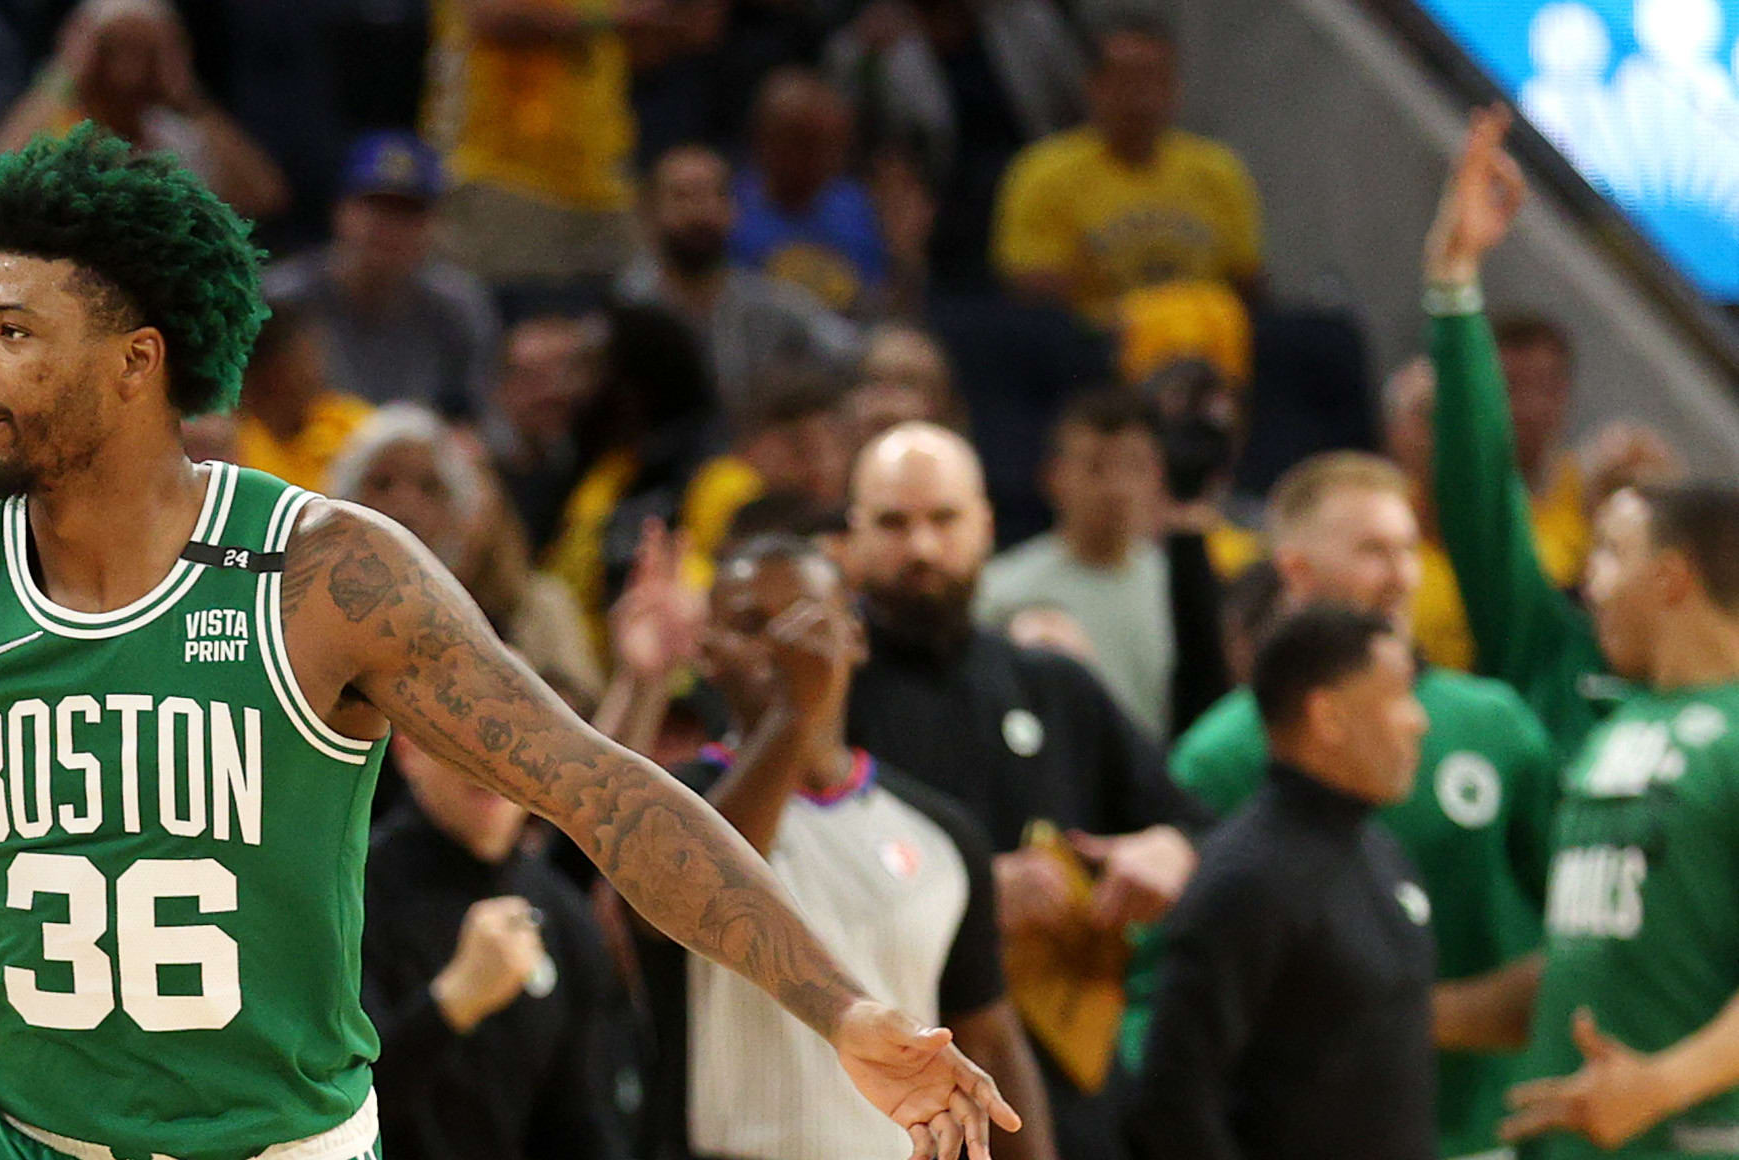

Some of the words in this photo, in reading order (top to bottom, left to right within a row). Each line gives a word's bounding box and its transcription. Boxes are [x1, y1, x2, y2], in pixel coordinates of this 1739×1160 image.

[223, 549, 250, 569] 24
[185, 609, 248, 639] VISTA
[184, 639, 248, 663] PRINT
[4, 852, 243, 1032] 36
